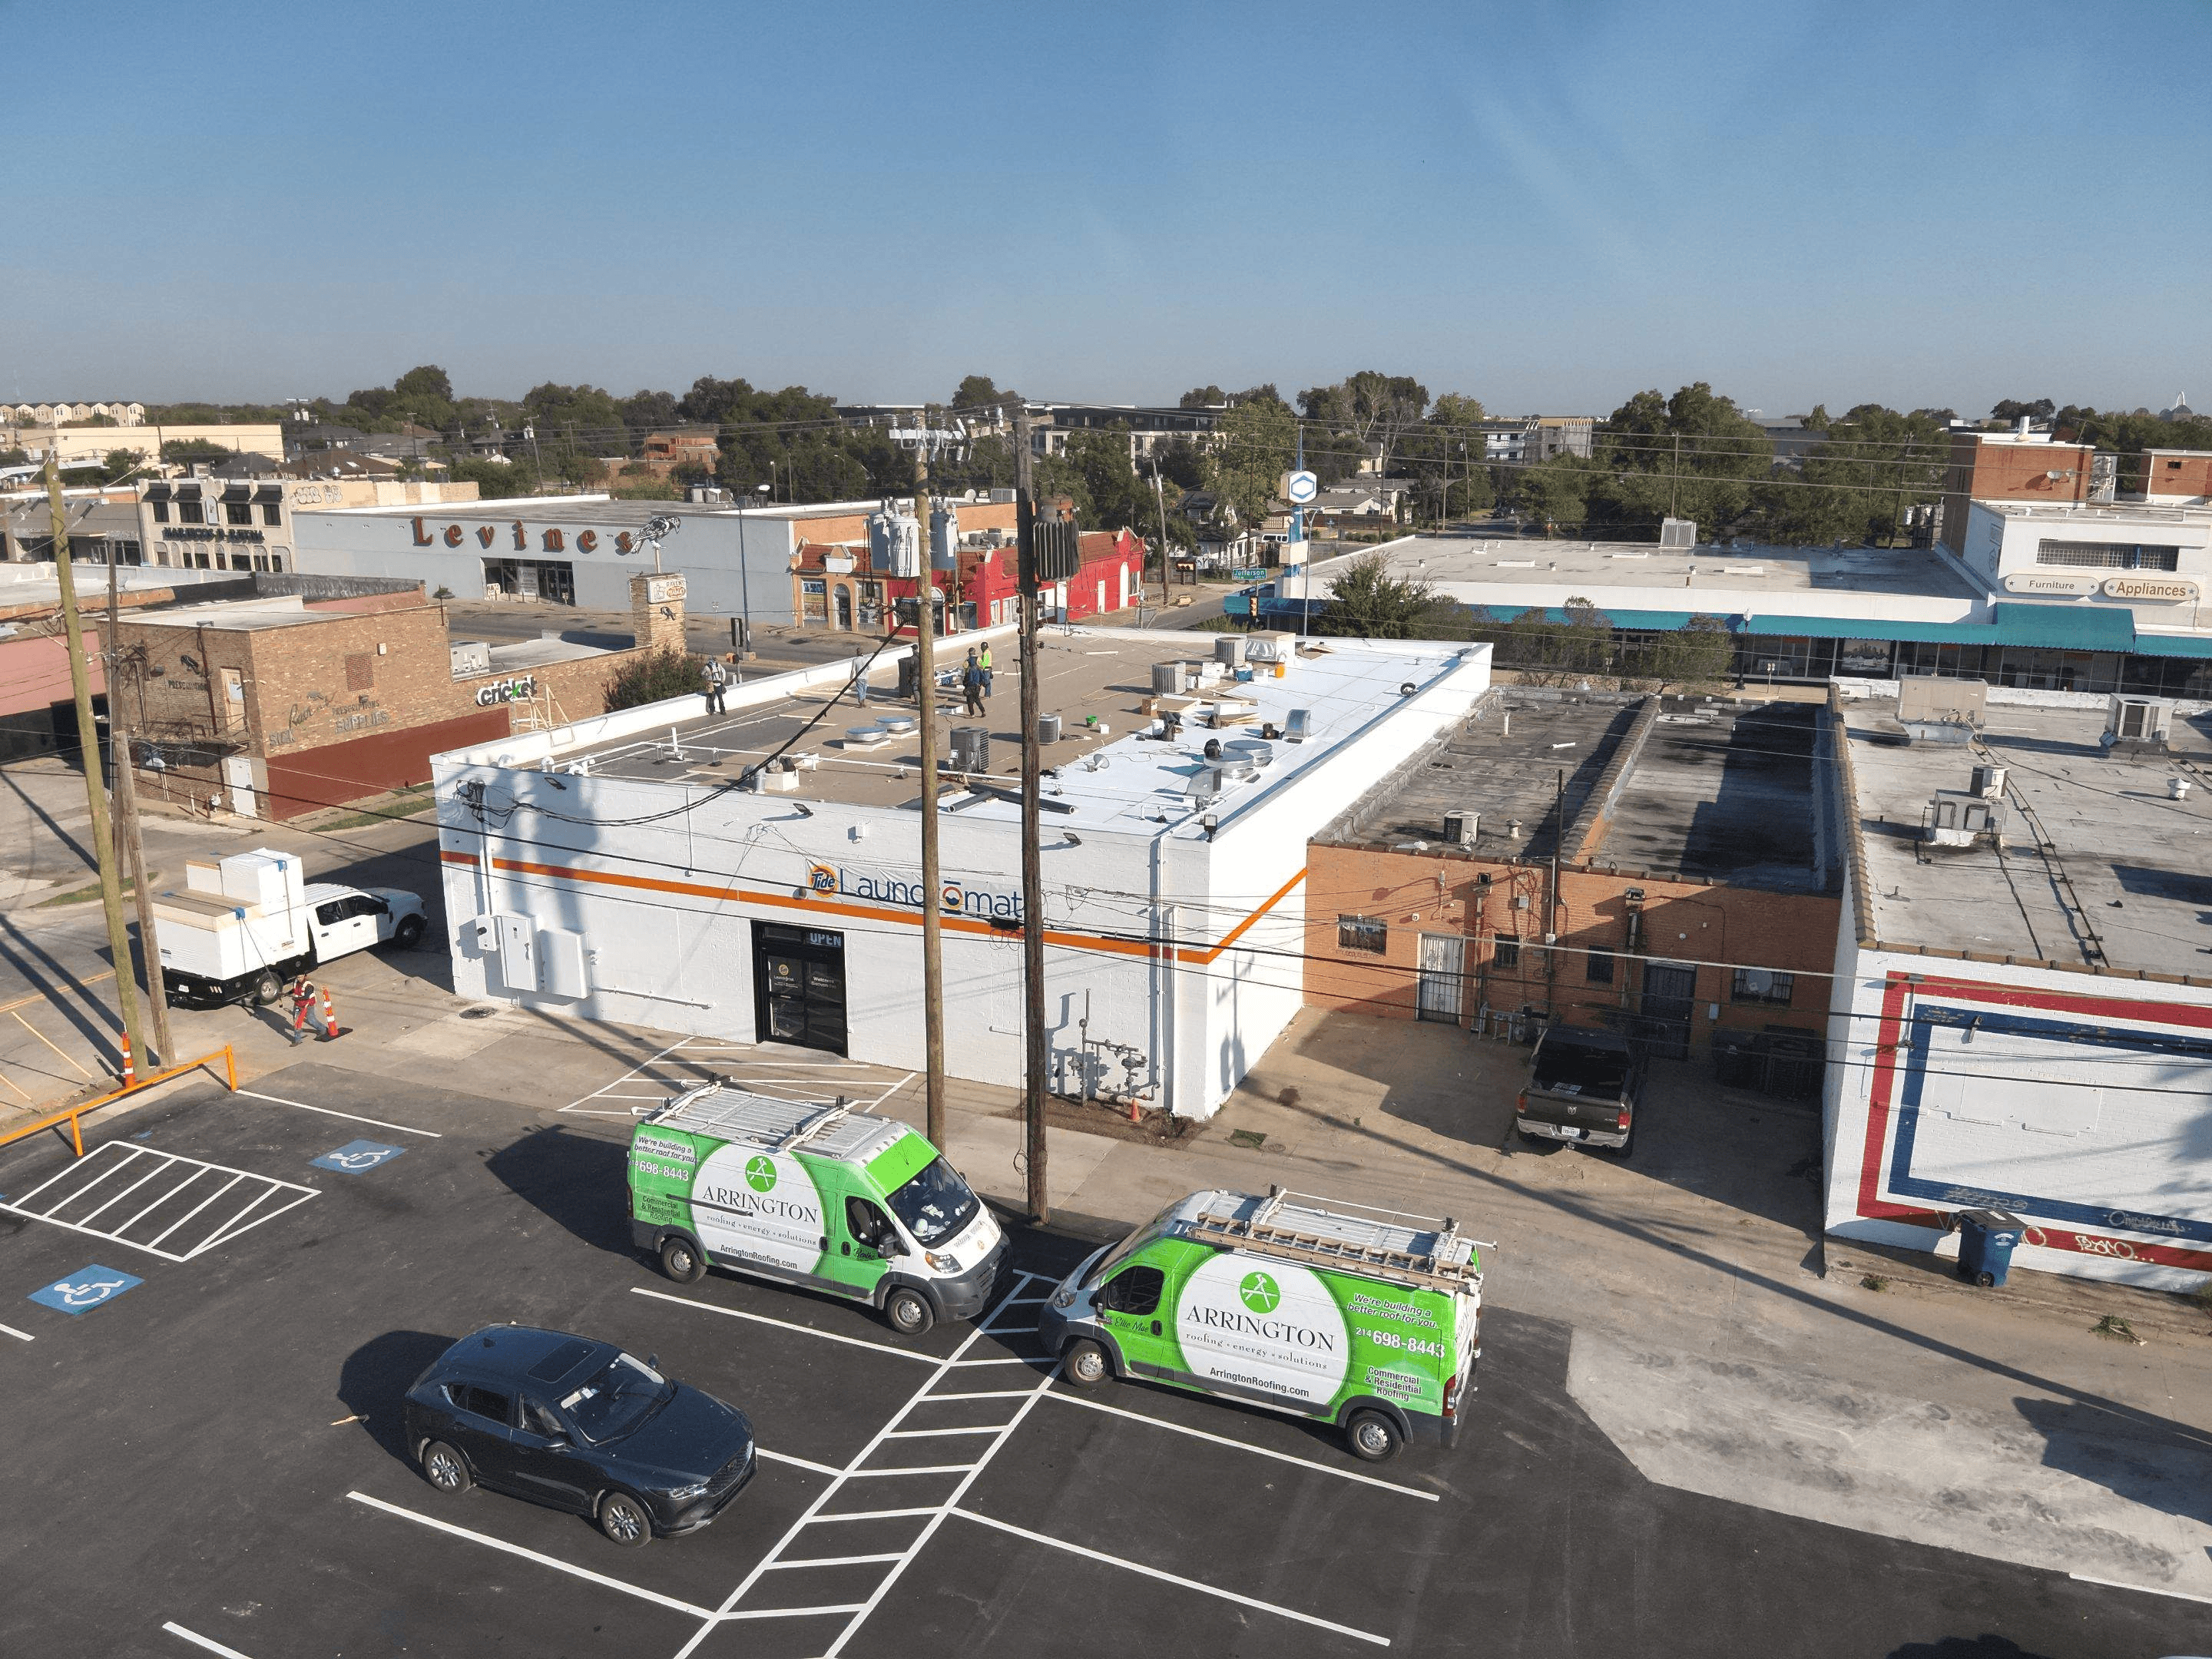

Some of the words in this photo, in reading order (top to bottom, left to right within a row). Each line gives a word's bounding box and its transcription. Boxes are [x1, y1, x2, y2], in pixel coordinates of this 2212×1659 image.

[411, 515, 633, 555] Levines
[2028, 580, 2075, 590] Furniture
[2115, 581, 2187, 597] Appliances
[476, 674, 537, 707] cricket
[811, 872, 836, 890] Tide
[634, 1144, 654, 1154] better
[655, 1149, 669, 1157] roof
[670, 1151, 680, 1160] for
[638, 1136, 657, 1146] We're
[659, 1141, 686, 1153] building
[639, 1161, 689, 1181] 698-8443
[642, 1195, 678, 1210] Commercial
[647, 1204, 680, 1218] Residential
[702, 1185, 819, 1224] ARRINGTON
[650, 1211, 673, 1225] Roofing
[707, 1215, 737, 1227] roofing
[743, 1223, 771, 1236] energy
[778, 1230, 817, 1246] solutions
[720, 1244, 798, 1270] ArringtonRoofing.com
[1354, 1293, 1382, 1306] We're
[1383, 1300, 1422, 1316] building
[1347, 1303, 1376, 1316] better
[1379, 1310, 1399, 1321] roof
[1402, 1314, 1416, 1325] for
[1417, 1320, 1439, 1330] you.
[1185, 1304, 1336, 1352] ARRINGTON
[1186, 1333, 1224, 1347] roofing
[1233, 1343, 1267, 1358] energy
[1277, 1352, 1328, 1370] solutions
[1356, 1326, 1372, 1338] 214
[1373, 1330, 1445, 1358] 698-8443
[1210, 1366, 1310, 1398] ArringtonRoofing.com
[1365, 1375, 1372, 1383] &
[1373, 1376, 1422, 1395] Residential
[1368, 1366, 1419, 1385] Commercial
[1376, 1386, 1409, 1402] Roofing
